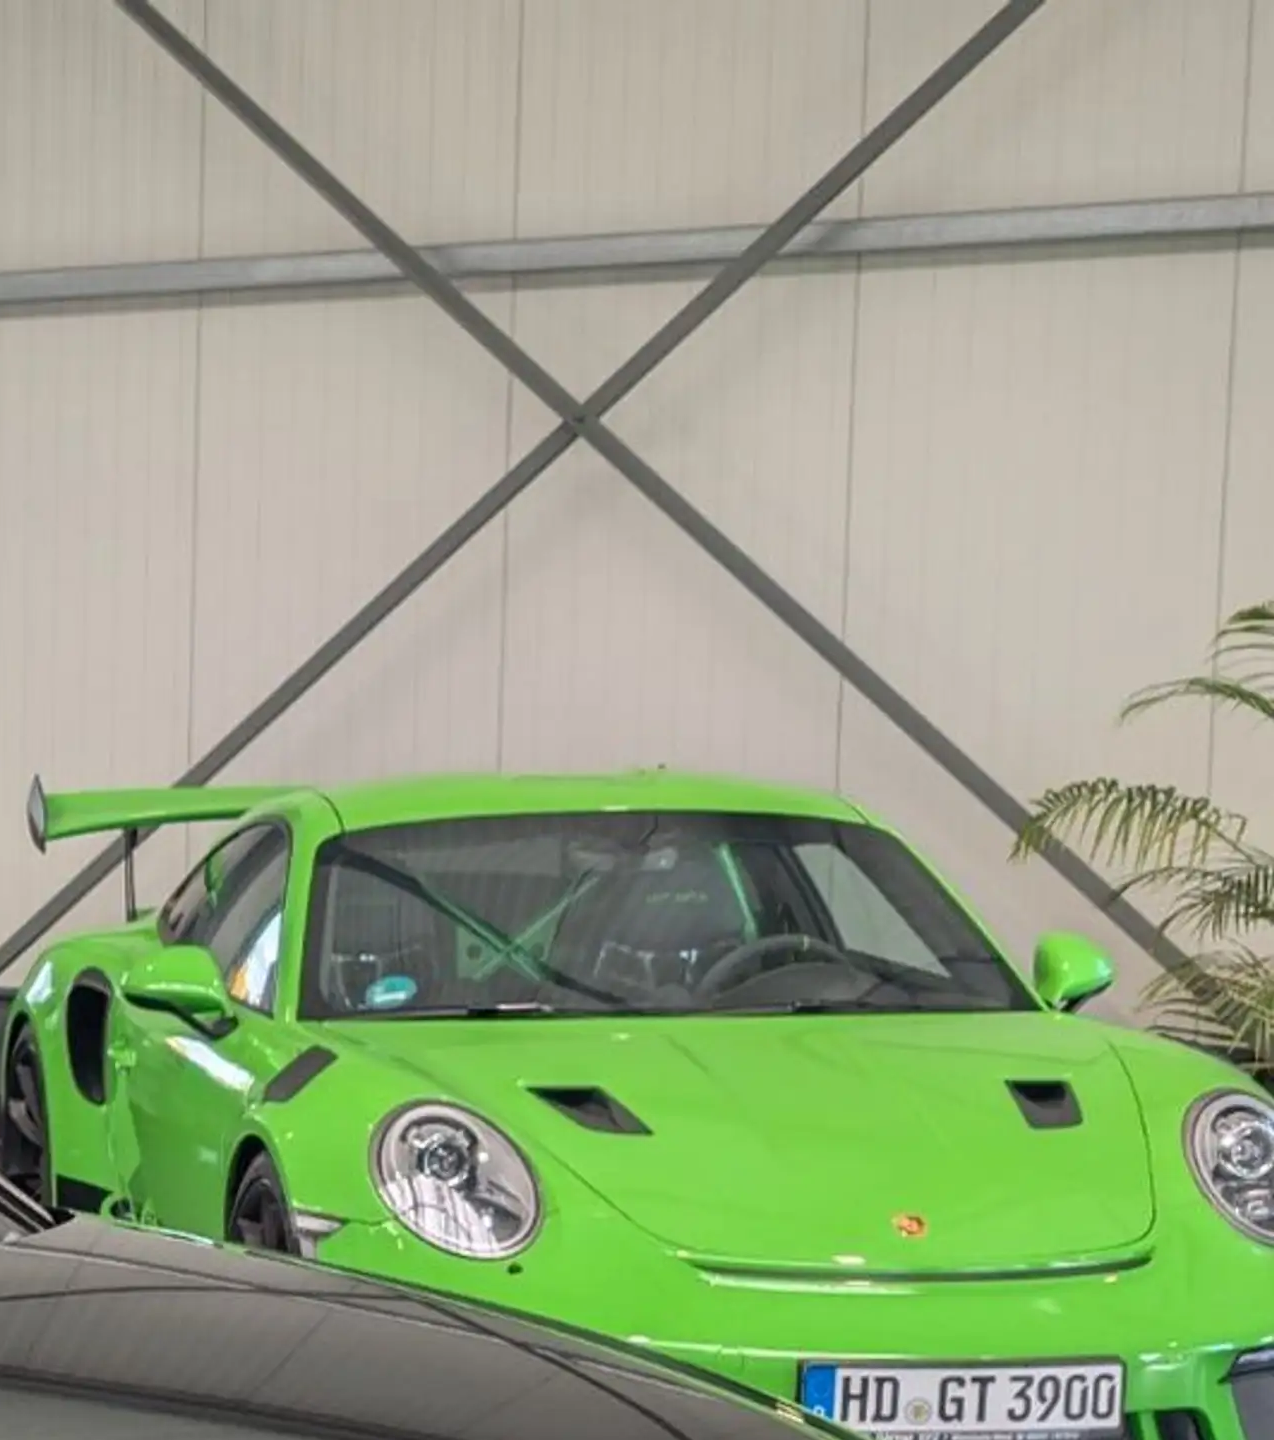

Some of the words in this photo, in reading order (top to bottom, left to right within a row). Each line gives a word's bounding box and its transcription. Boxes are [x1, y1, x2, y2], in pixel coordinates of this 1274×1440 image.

[840, 1375, 900, 1422] HD
[938, 1375, 996, 1422] GT
[1007, 1373, 1117, 1423] 3900
